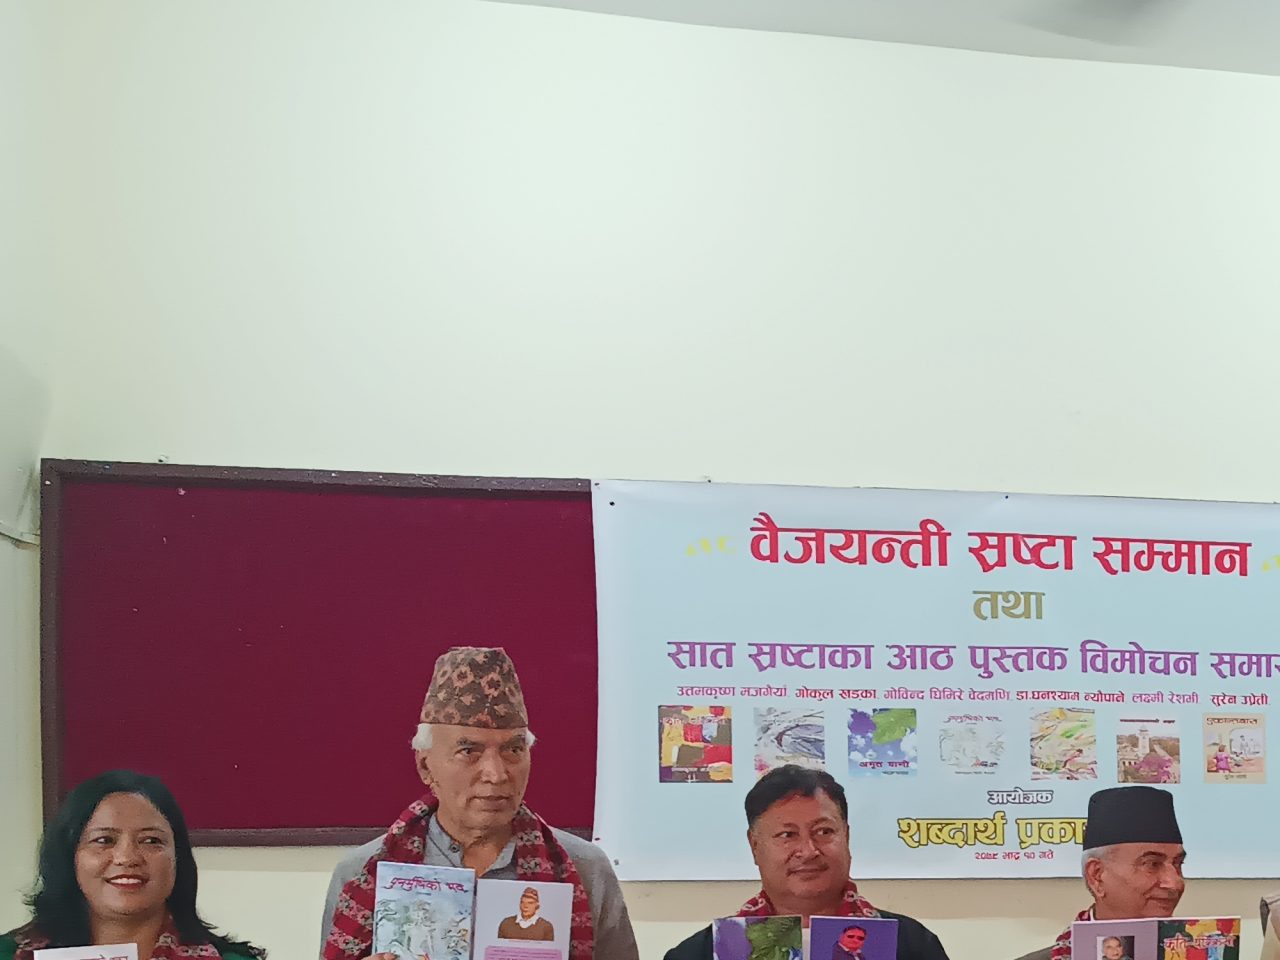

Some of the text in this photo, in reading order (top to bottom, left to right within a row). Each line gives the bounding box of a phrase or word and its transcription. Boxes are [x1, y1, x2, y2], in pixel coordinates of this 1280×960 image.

[750, 511, 1252, 577] वैजयन्ती स्रष्टा सम्मान
[972, 590, 1046, 621] तथा
[667, 642, 737, 669] सात
[748, 643, 875, 672] स्रष्टाका
[886, 644, 957, 671] आठ
[968, 646, 1069, 679] पुस्तक
[1080, 639, 1199, 677] विमोचन
[987, 787, 1054, 805] आयोजक
[898, 811, 1088, 849] शब्दार्थ प्रका
